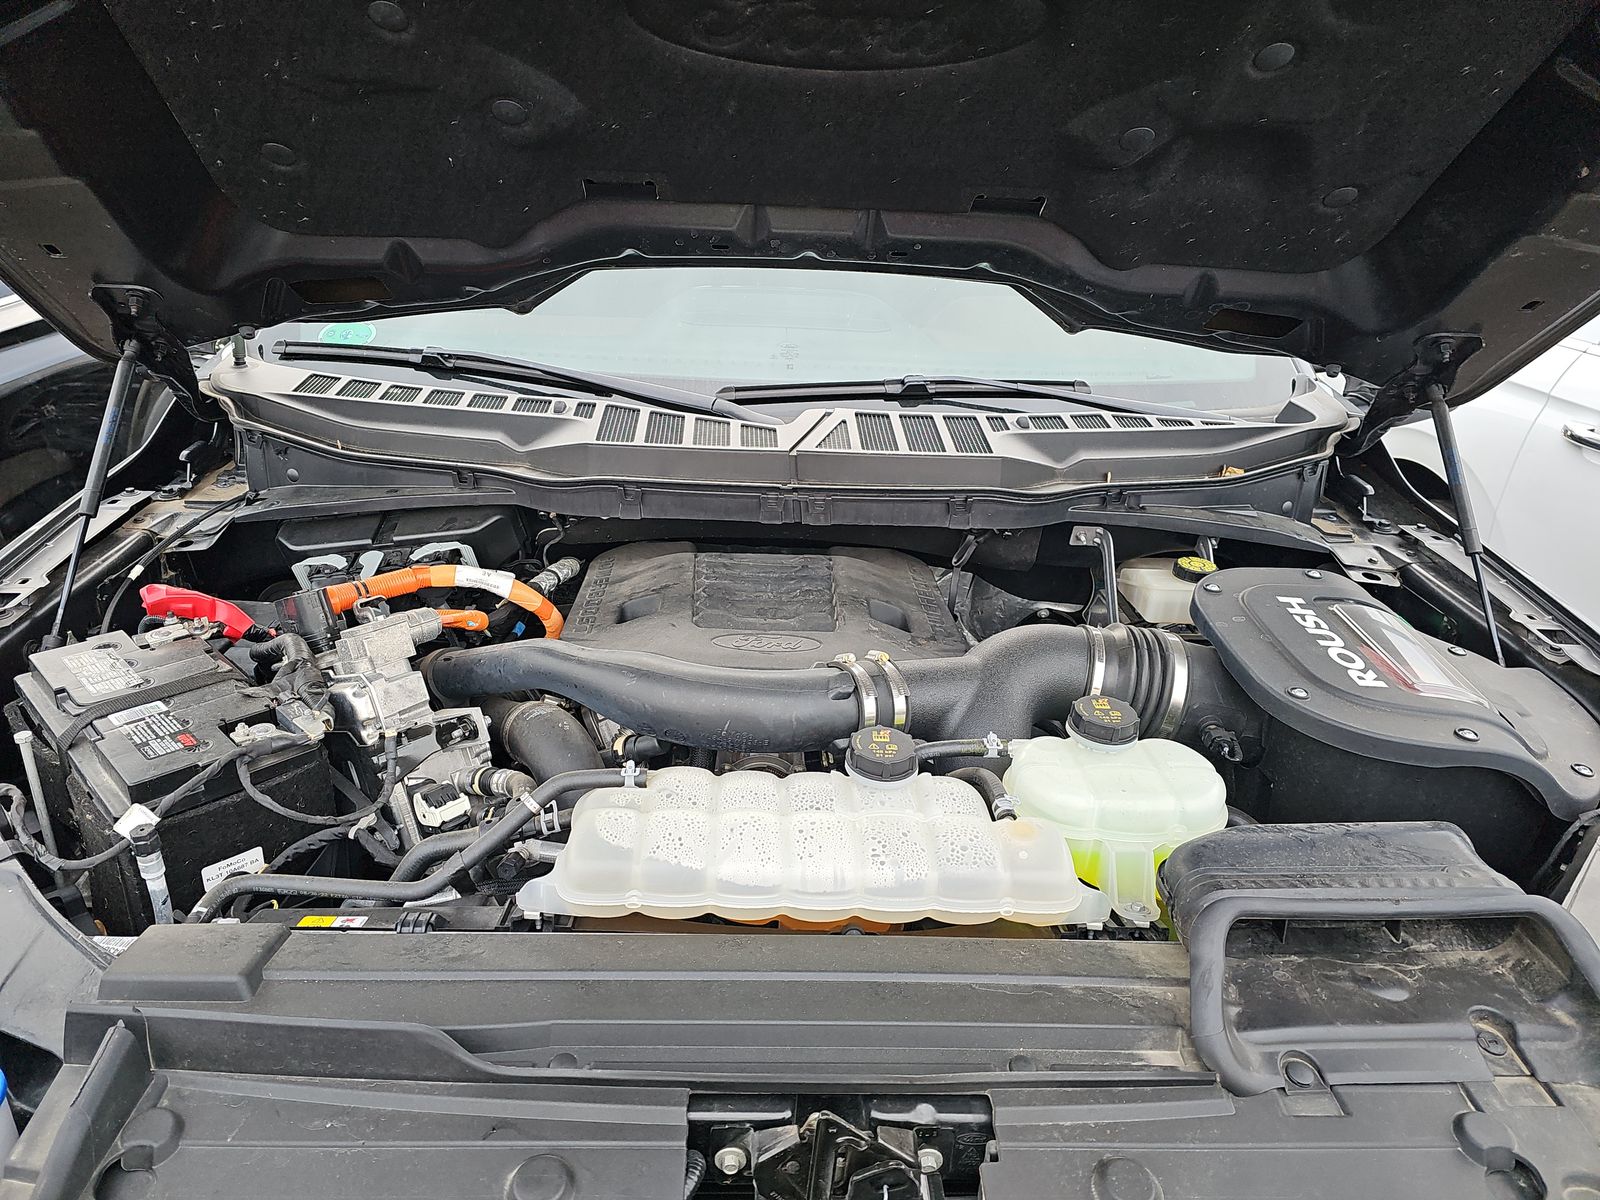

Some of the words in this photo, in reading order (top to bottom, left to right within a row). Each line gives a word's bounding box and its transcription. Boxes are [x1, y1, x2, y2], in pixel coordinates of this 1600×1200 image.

[731, 634, 803, 650] Ford
[1275, 595, 1389, 688] ROUSH
[217, 857, 246, 872] FoMoCo
